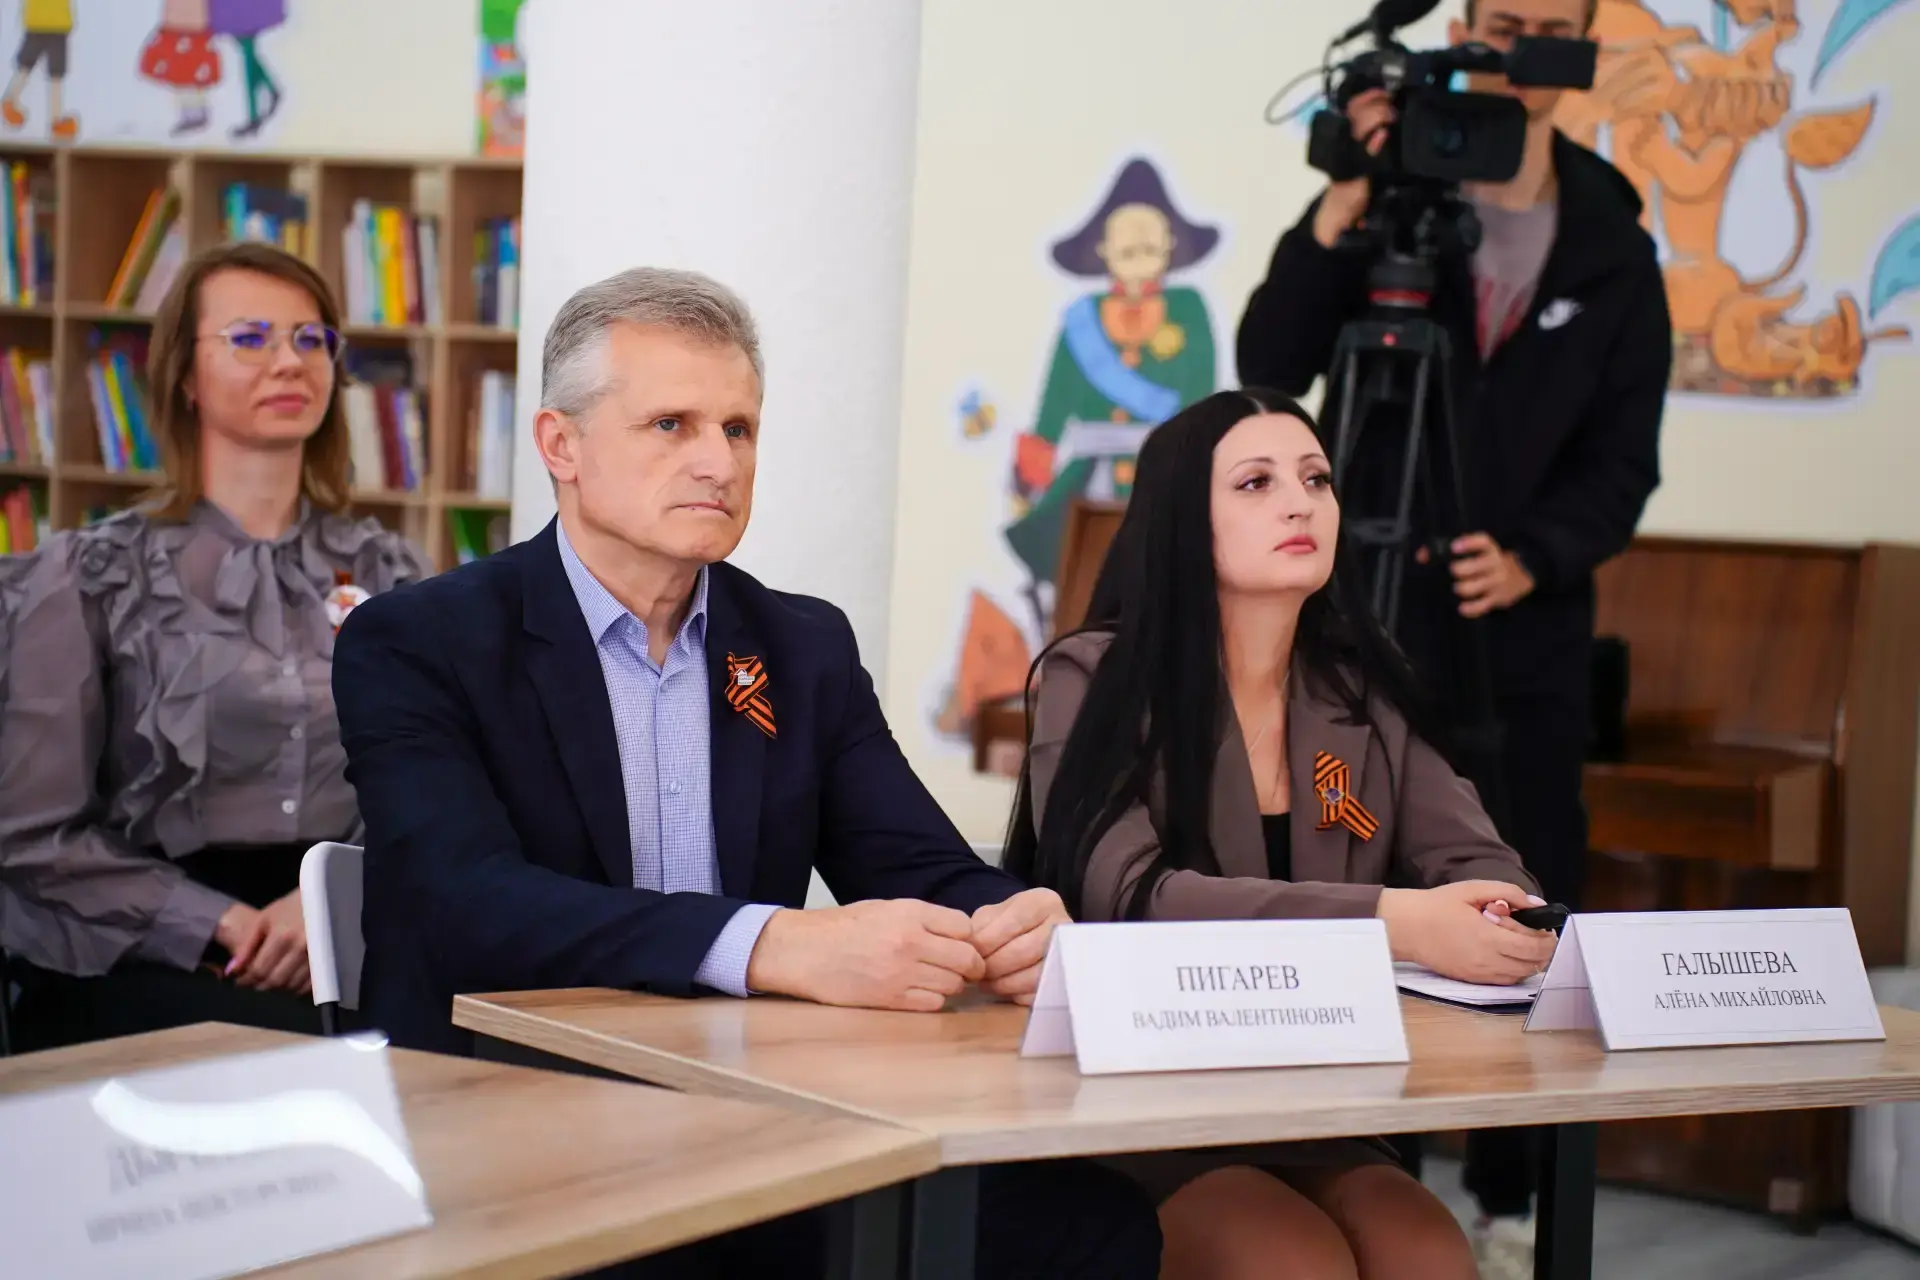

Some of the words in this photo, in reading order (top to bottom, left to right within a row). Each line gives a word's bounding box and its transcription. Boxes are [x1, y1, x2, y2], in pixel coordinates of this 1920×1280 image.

[1661, 951, 1798, 975] ГАЛЫШЕВА
[1176, 965, 1300, 991] ПИГАРЕВ
[1654, 990, 1709, 1010] АЛЁНА
[1710, 987, 1827, 1008] МИХАЙЛОВНА
[1132, 1010, 1201, 1031] ВАДИМ
[1205, 1006, 1356, 1028] ВАЛЕНТИНОВИЧ
